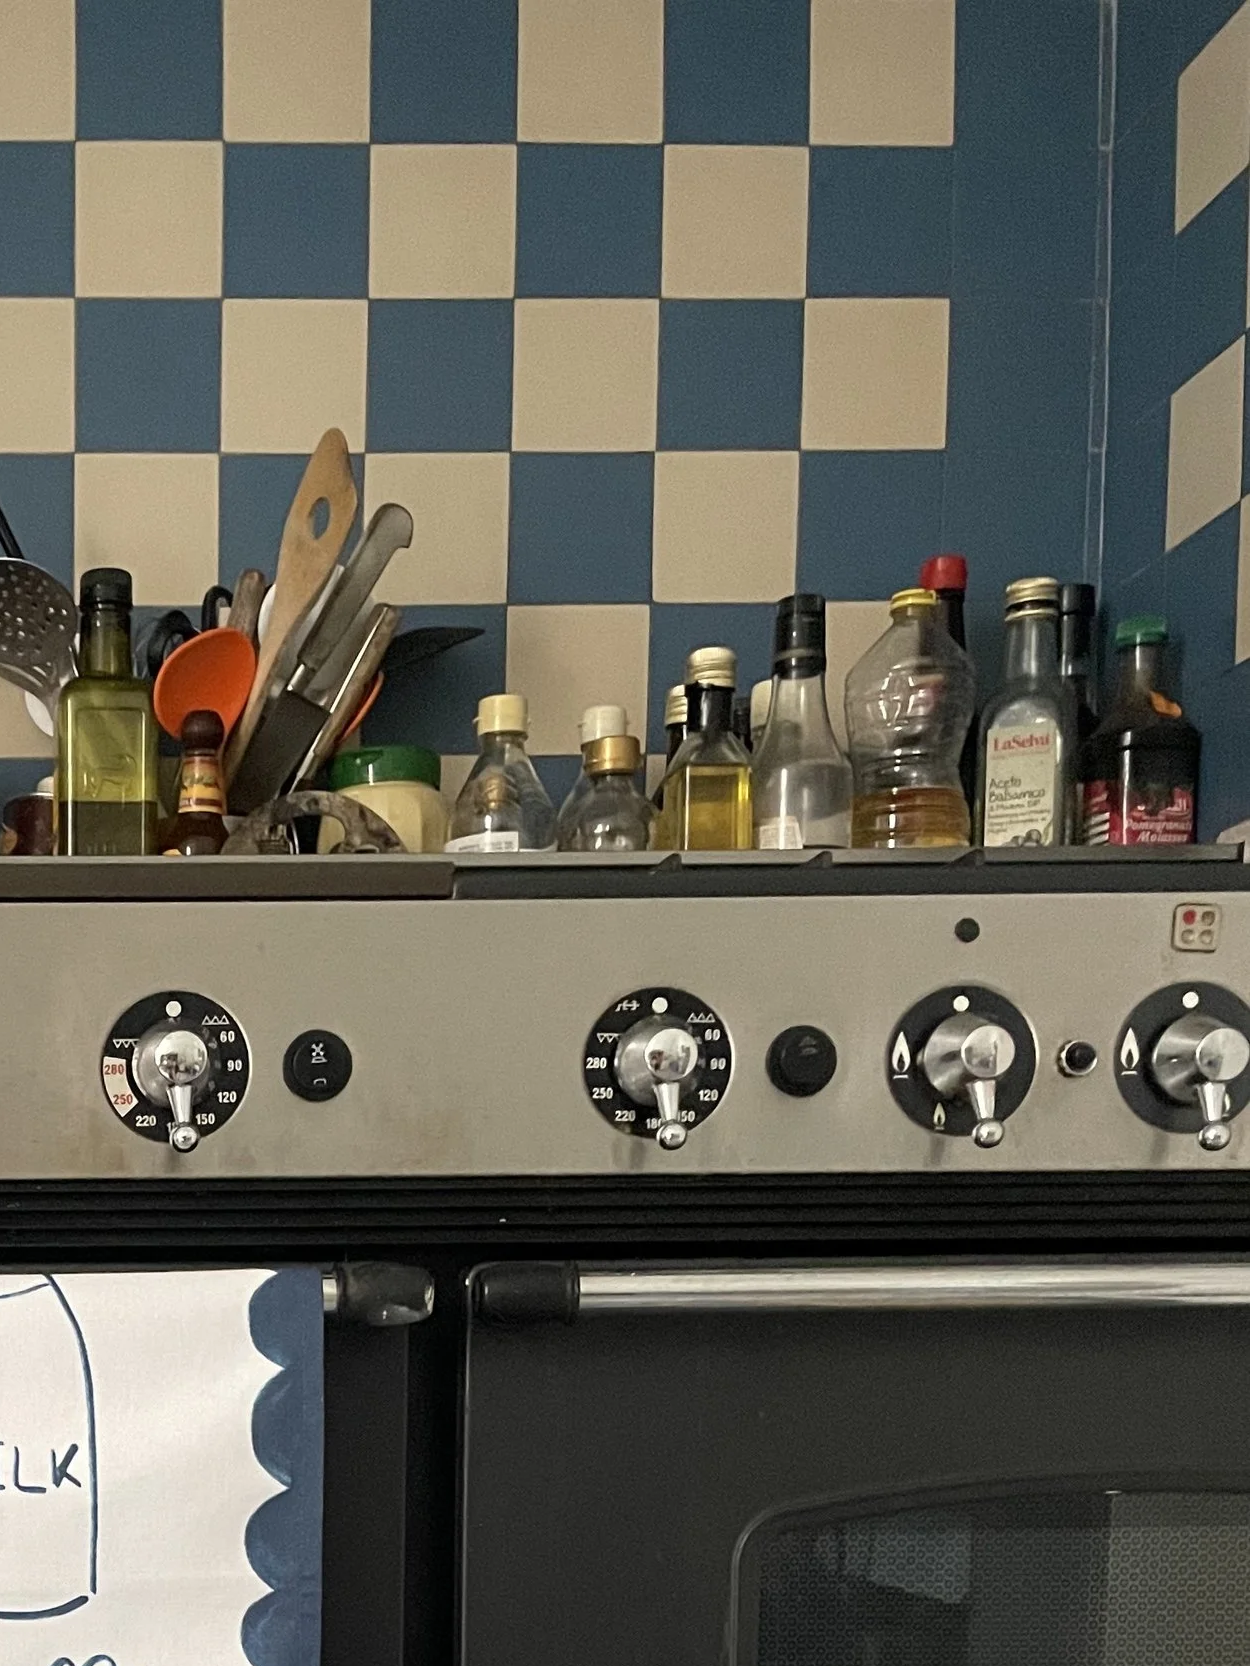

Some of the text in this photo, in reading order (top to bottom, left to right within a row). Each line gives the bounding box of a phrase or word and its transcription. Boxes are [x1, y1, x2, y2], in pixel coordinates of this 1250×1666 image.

[219, 1030, 235, 1043] 60
[704, 1029, 721, 1041] 60
[104, 1064, 125, 1075] 280
[226, 1060, 243, 1072] 90
[585, 1057, 608, 1070] 280
[709, 1058, 726, 1070] 90
[113, 1094, 133, 1105] 250
[216, 1091, 237, 1104] 120
[592, 1087, 614, 1100] 250
[698, 1089, 719, 1101] 120
[135, 1115, 157, 1127] 220
[195, 1113, 216, 1125] 150
[614, 1110, 636, 1122] 220
